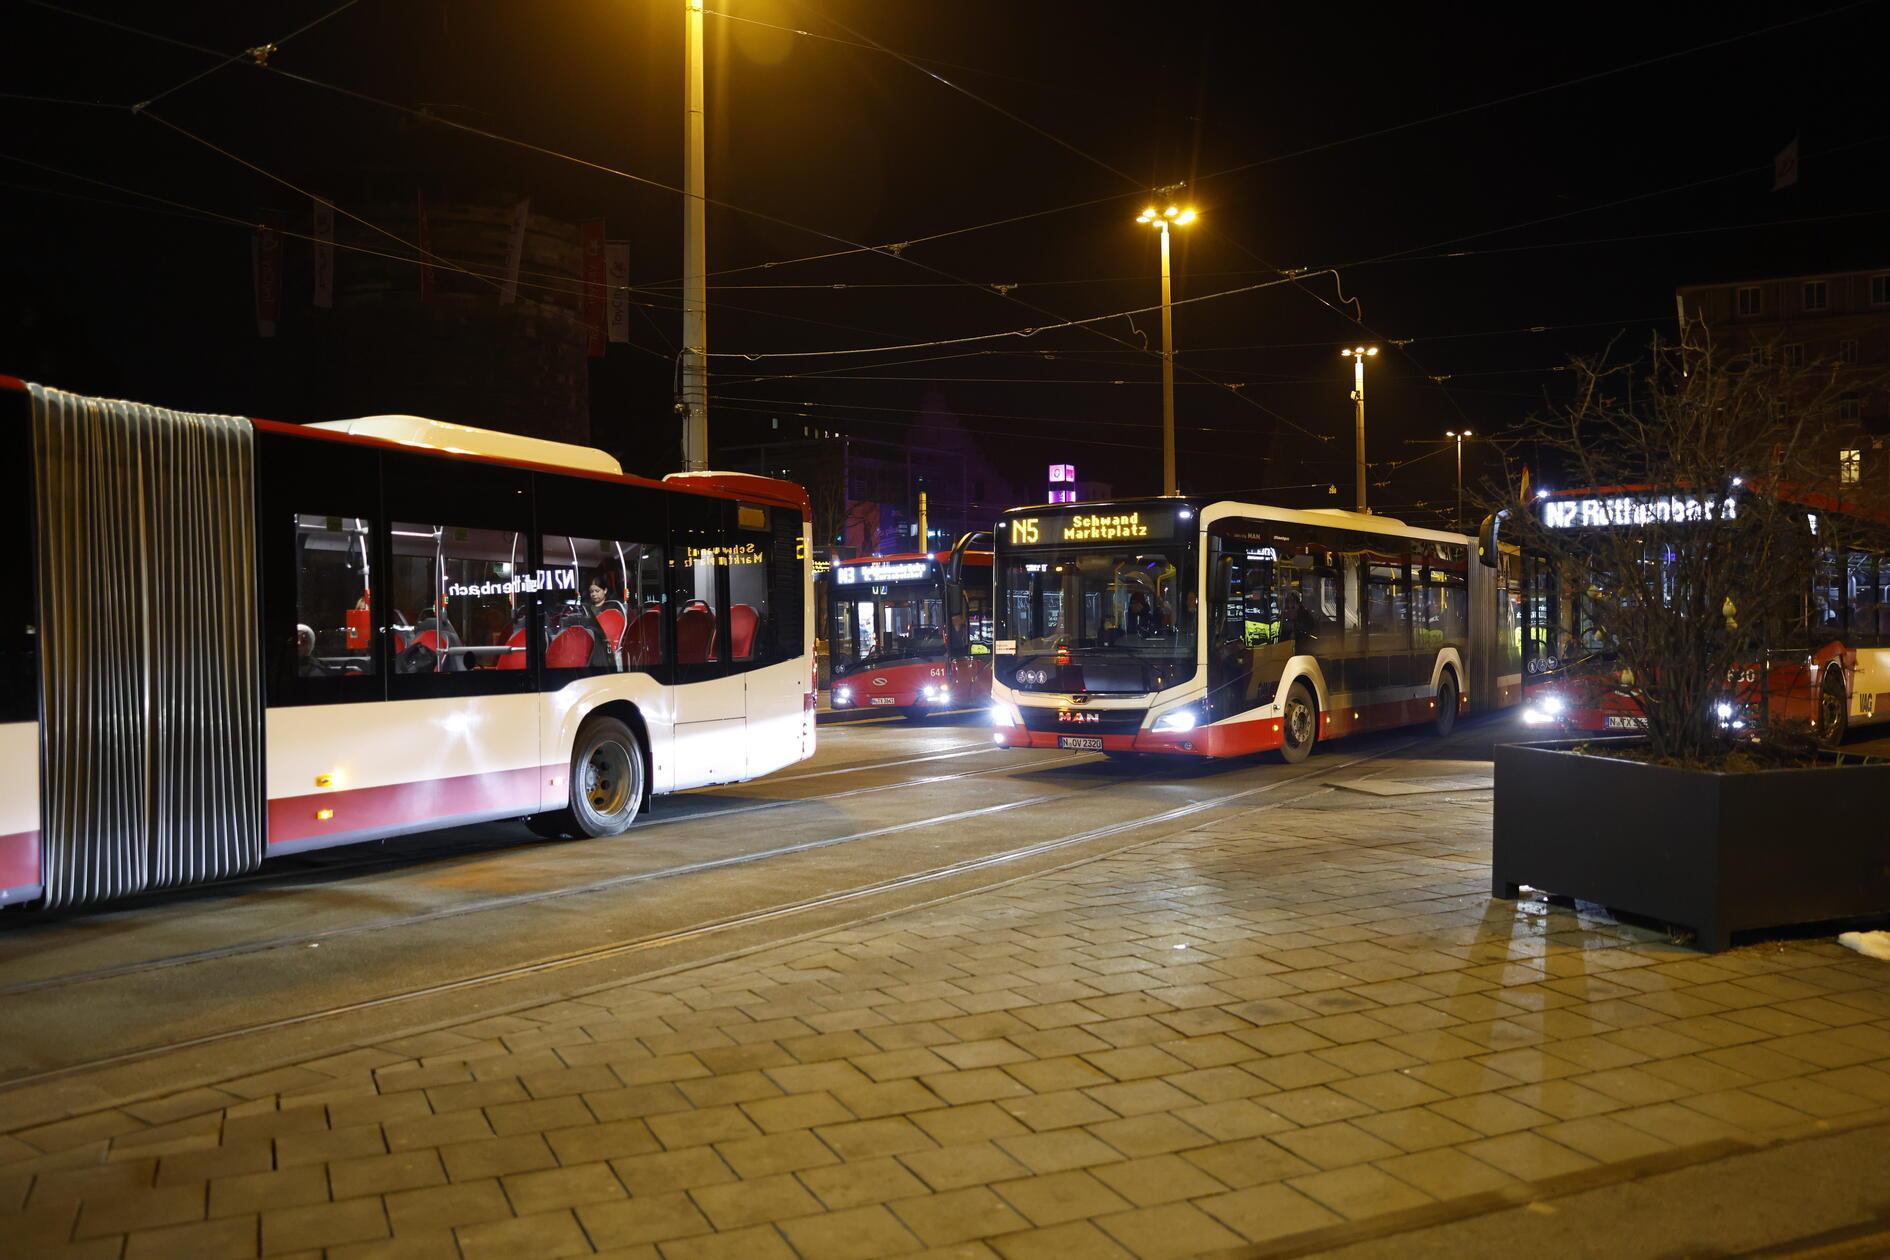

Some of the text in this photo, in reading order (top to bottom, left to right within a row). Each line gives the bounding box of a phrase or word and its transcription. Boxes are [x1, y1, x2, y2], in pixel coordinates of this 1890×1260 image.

[1073, 512, 1139, 528] Schwand
[1012, 518, 1039, 544] N5
[1064, 524, 1148, 540] Marktplatz
[930, 668, 945, 677] 641
[1859, 693, 1873, 713] VAG
[1058, 712, 1100, 724] MAN
[1082, 739, 1101, 748] 2320
